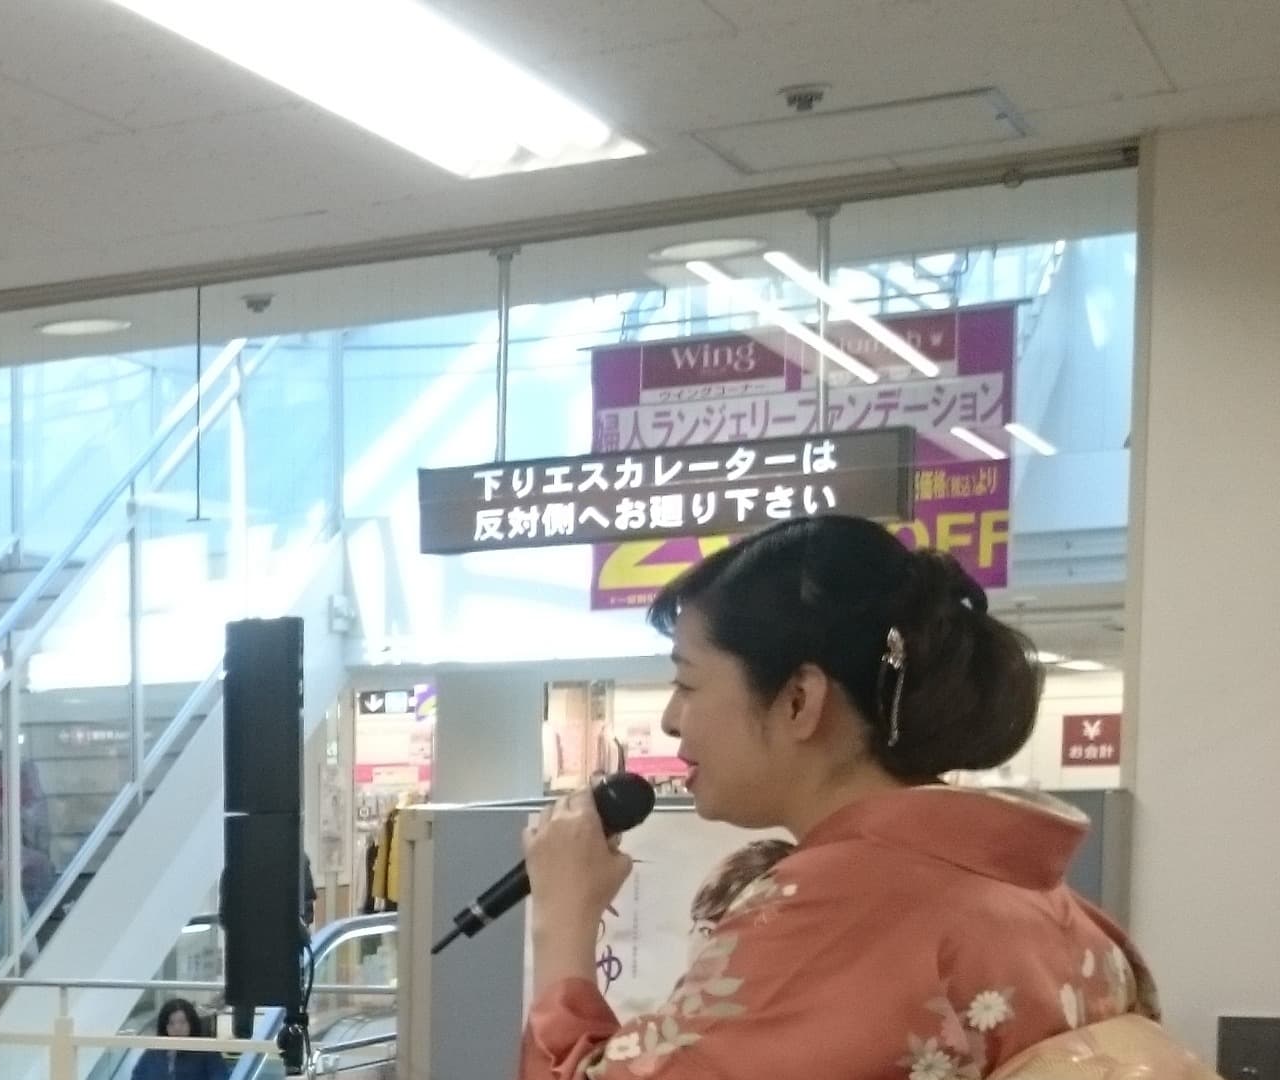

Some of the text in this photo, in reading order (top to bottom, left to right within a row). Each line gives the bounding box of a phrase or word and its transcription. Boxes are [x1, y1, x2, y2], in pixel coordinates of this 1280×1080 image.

[473, 439, 838, 502] 下りエスカレーターは
[473, 485, 836, 542] 反対側へお廻り下さい
